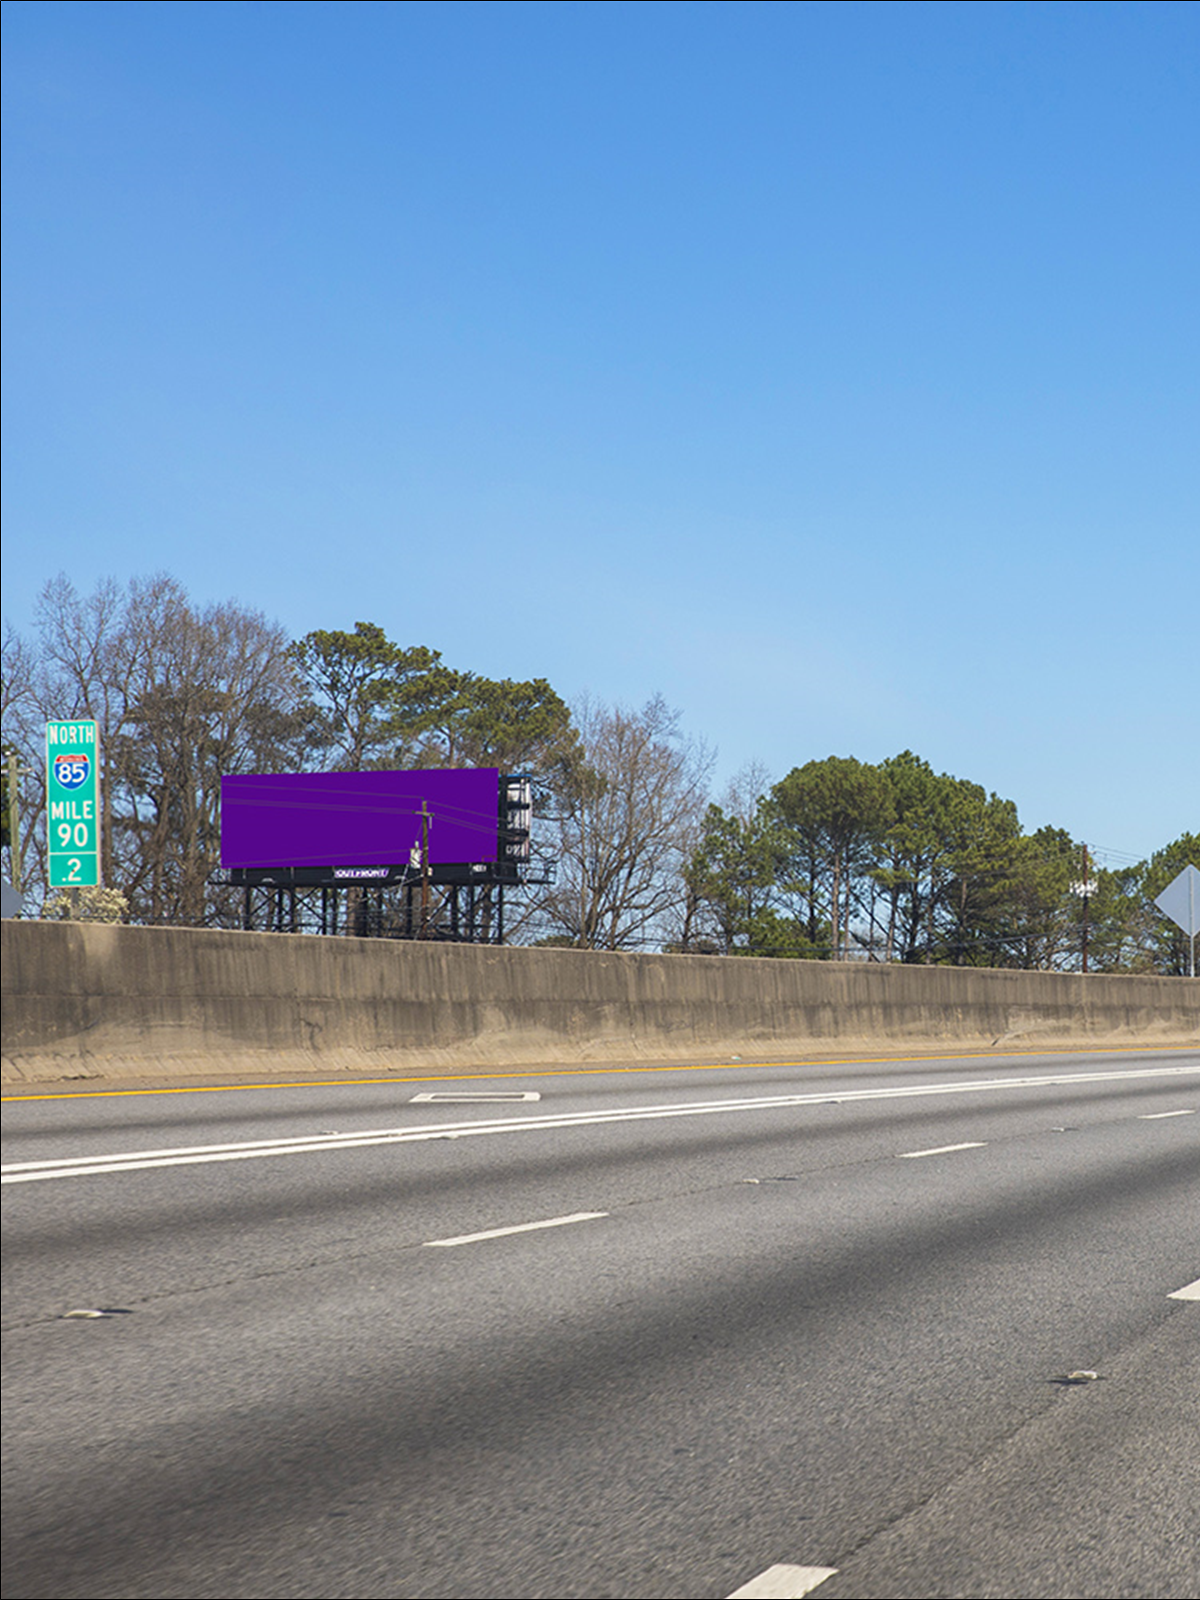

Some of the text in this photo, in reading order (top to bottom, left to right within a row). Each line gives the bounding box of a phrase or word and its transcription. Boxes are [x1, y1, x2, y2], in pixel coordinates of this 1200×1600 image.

[49, 724, 94, 745] NORTH
[58, 762, 85, 783] 85
[51, 800, 93, 820] MILE
[57, 822, 88, 847] 90
[62, 858, 82, 882] .2
